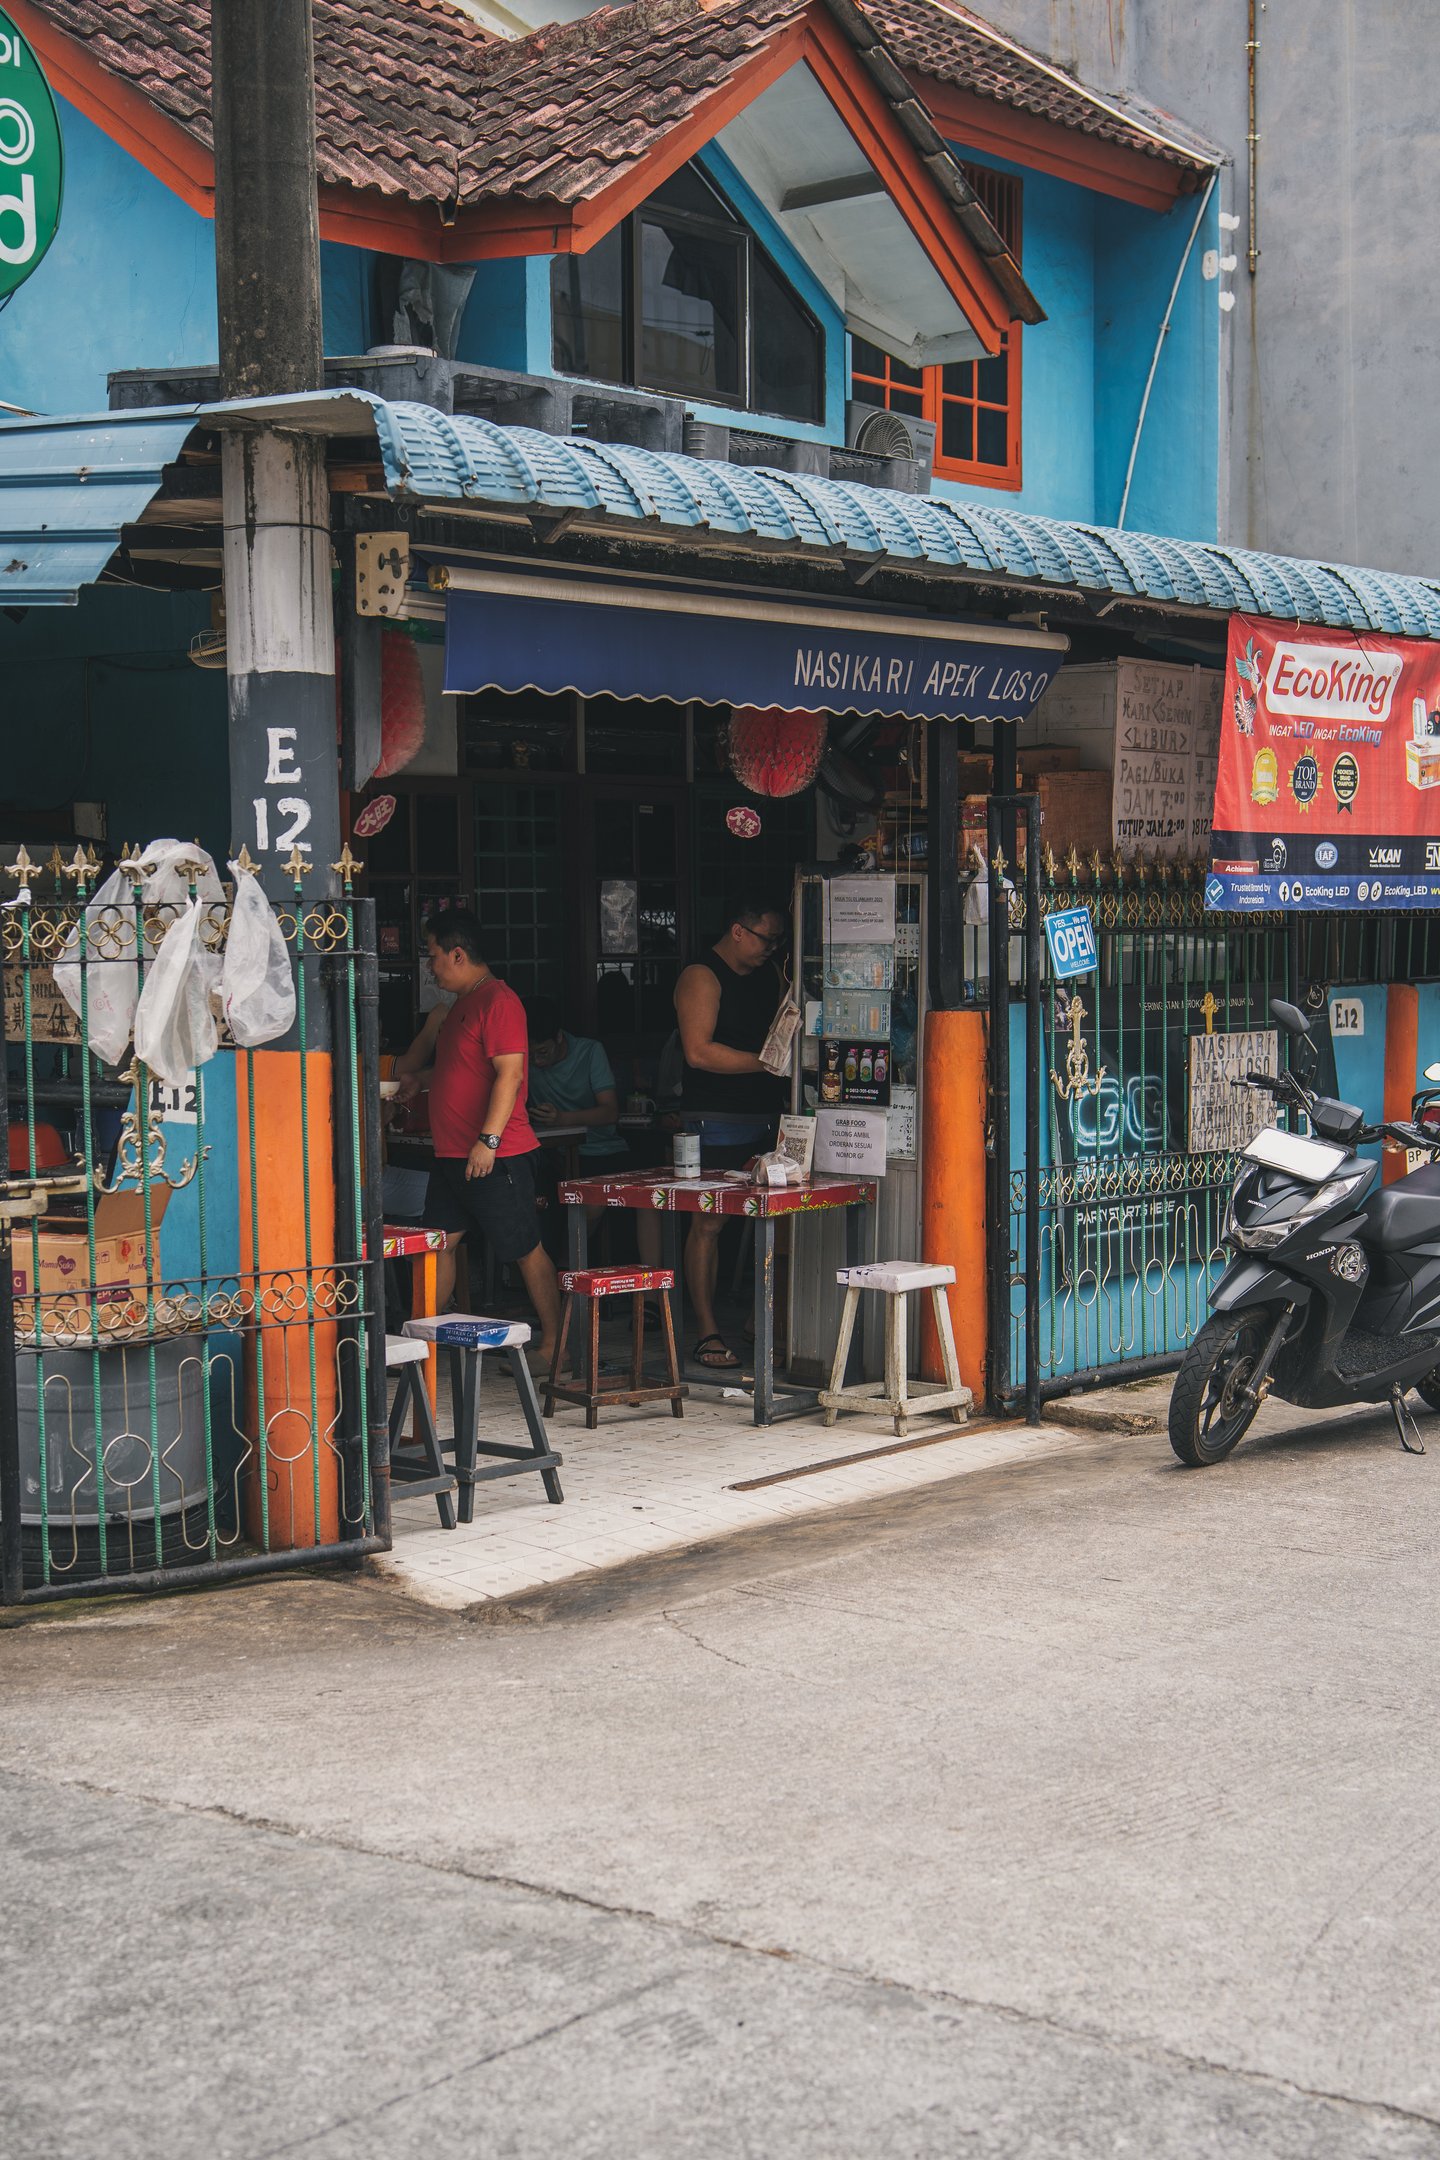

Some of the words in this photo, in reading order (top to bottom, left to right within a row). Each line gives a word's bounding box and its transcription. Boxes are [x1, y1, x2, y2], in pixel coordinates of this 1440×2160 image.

[923, 661, 985, 697] APEK
[988, 667, 1049, 703] LOSO
[1272, 654, 1393, 715] EcoKing
[1269, 724, 1292, 737] INGAT
[1293, 721, 1314, 739] LED
[1314, 729, 1337, 741] INGAT
[1338, 724, 1383, 748] EcoKing
[264, 727, 302, 784] E
[1296, 766, 1316, 781] TOP
[1295, 780, 1316, 789] BRAND
[253, 797, 312, 852] 12
[1319, 850, 1334, 861] IAF
[1263, 884, 1271, 894] by
[1305, 886, 1333, 898] EcoKing
[1335, 886, 1350, 896] LED
[1054, 923, 1095, 962] OPEN
[1335, 1003, 1359, 1029] E.12
[836, 1119, 850, 1127] GRAB
[832, 1130, 853, 1138] TOLONG
[1408, 1149, 1422, 1163] BP
[1247, 1199, 1267, 1209] HONDA
[1306, 1245, 1337, 1261] HONDA
